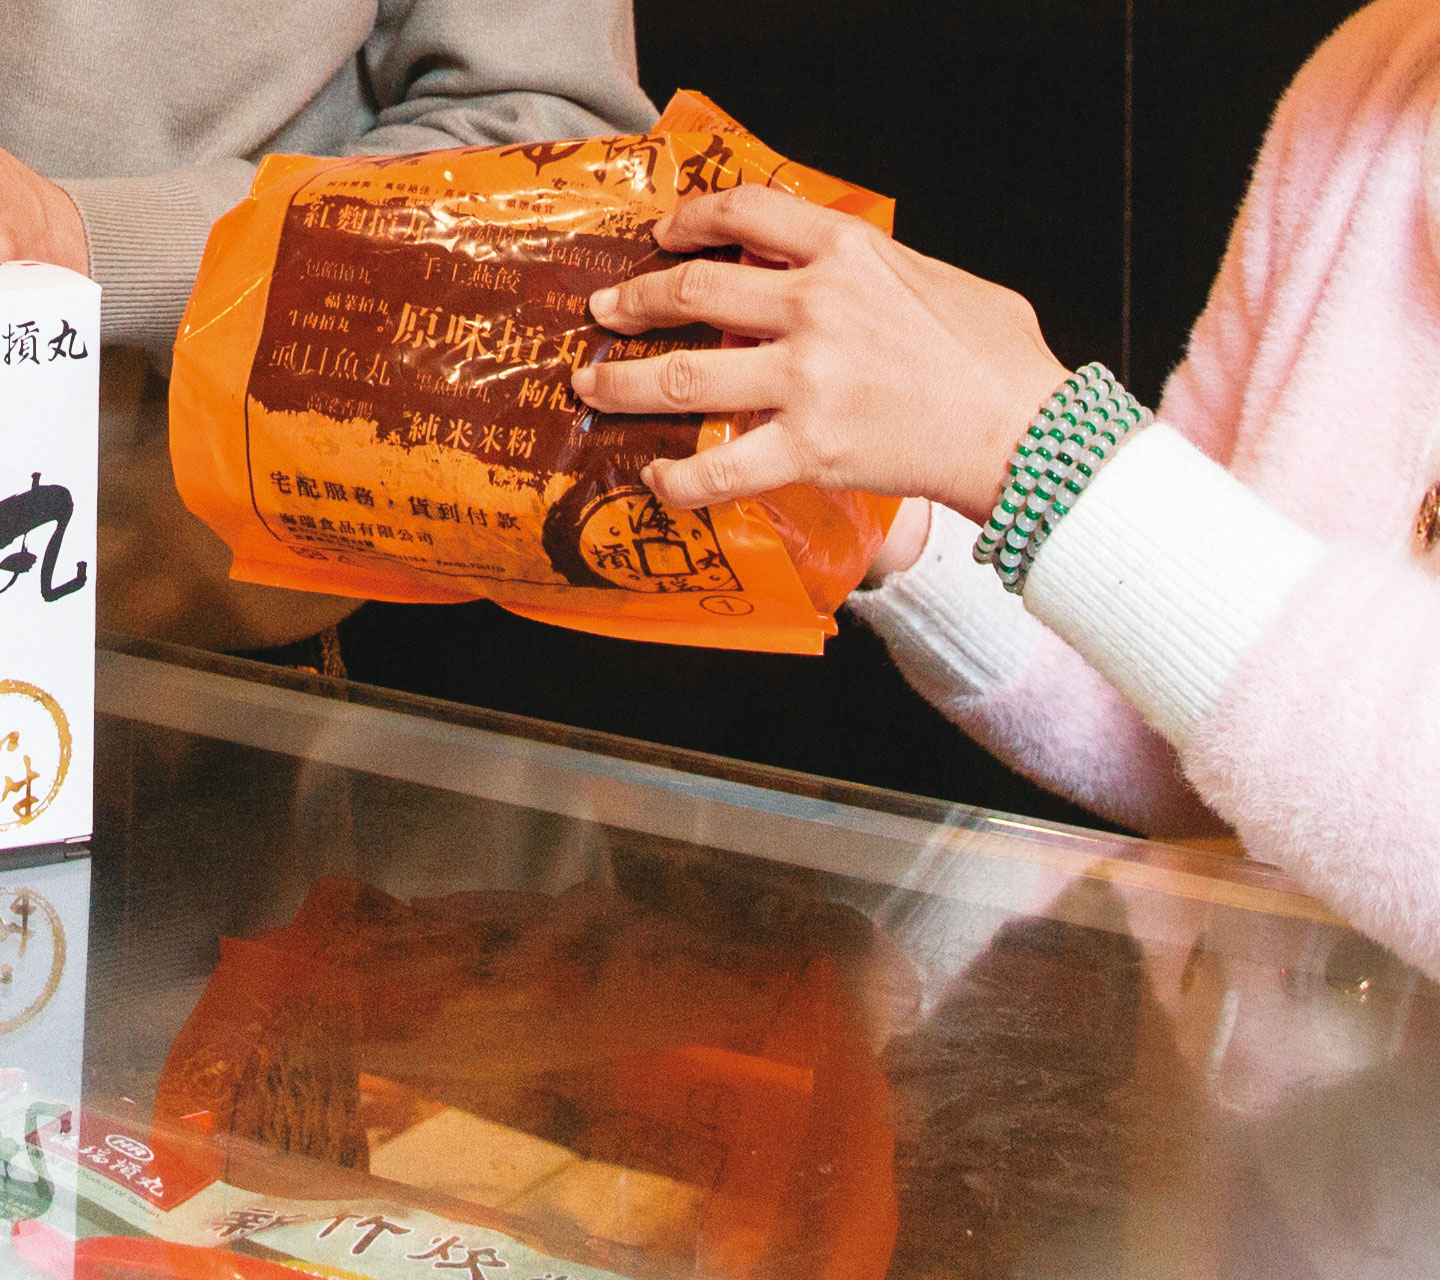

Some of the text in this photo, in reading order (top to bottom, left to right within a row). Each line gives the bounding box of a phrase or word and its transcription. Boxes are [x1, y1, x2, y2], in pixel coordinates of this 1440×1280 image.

[390, 301, 588, 374] 原味摃丸
[407, 410, 538, 460] 純米米粉
[214, 1206, 578, 1280] 新竹炊
